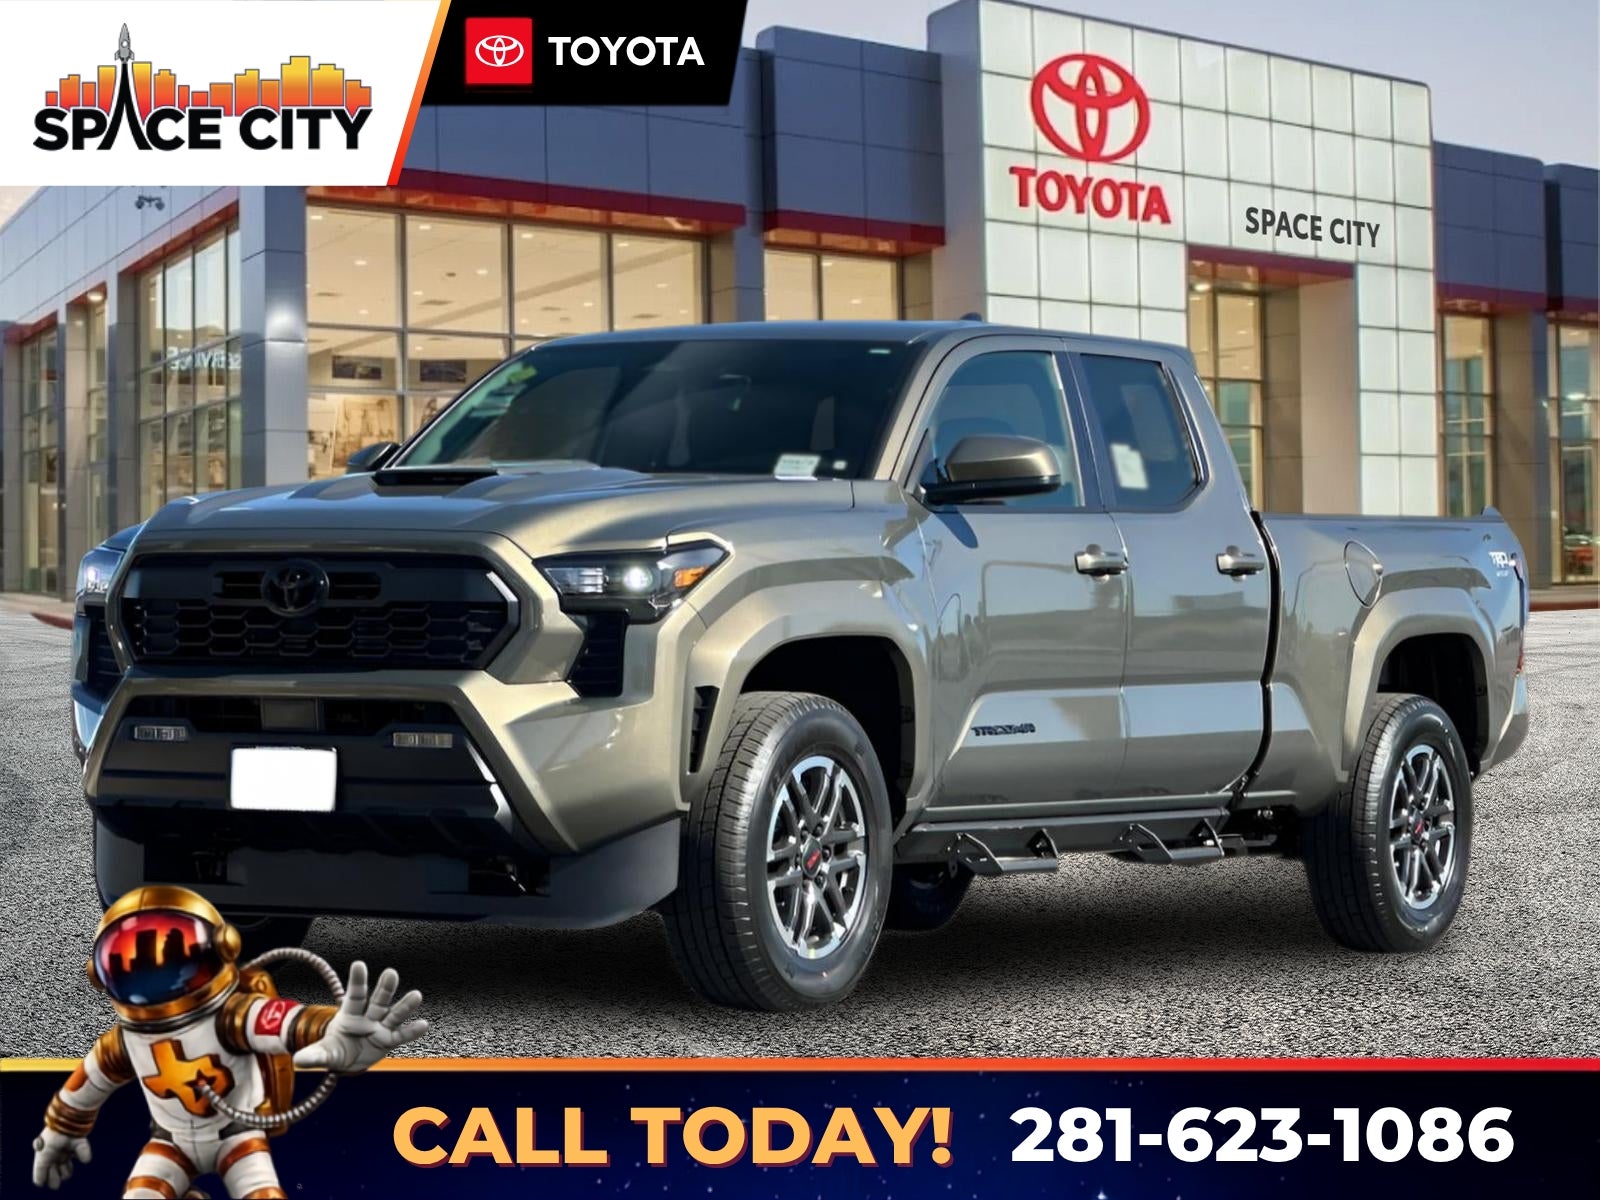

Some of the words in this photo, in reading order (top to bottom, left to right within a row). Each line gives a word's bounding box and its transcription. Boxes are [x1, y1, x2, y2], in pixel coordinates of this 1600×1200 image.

[1009, 166, 1171, 225] TOYOTA
[1245, 206, 1323, 242] SPACE
[1329, 217, 1381, 249] CITY
